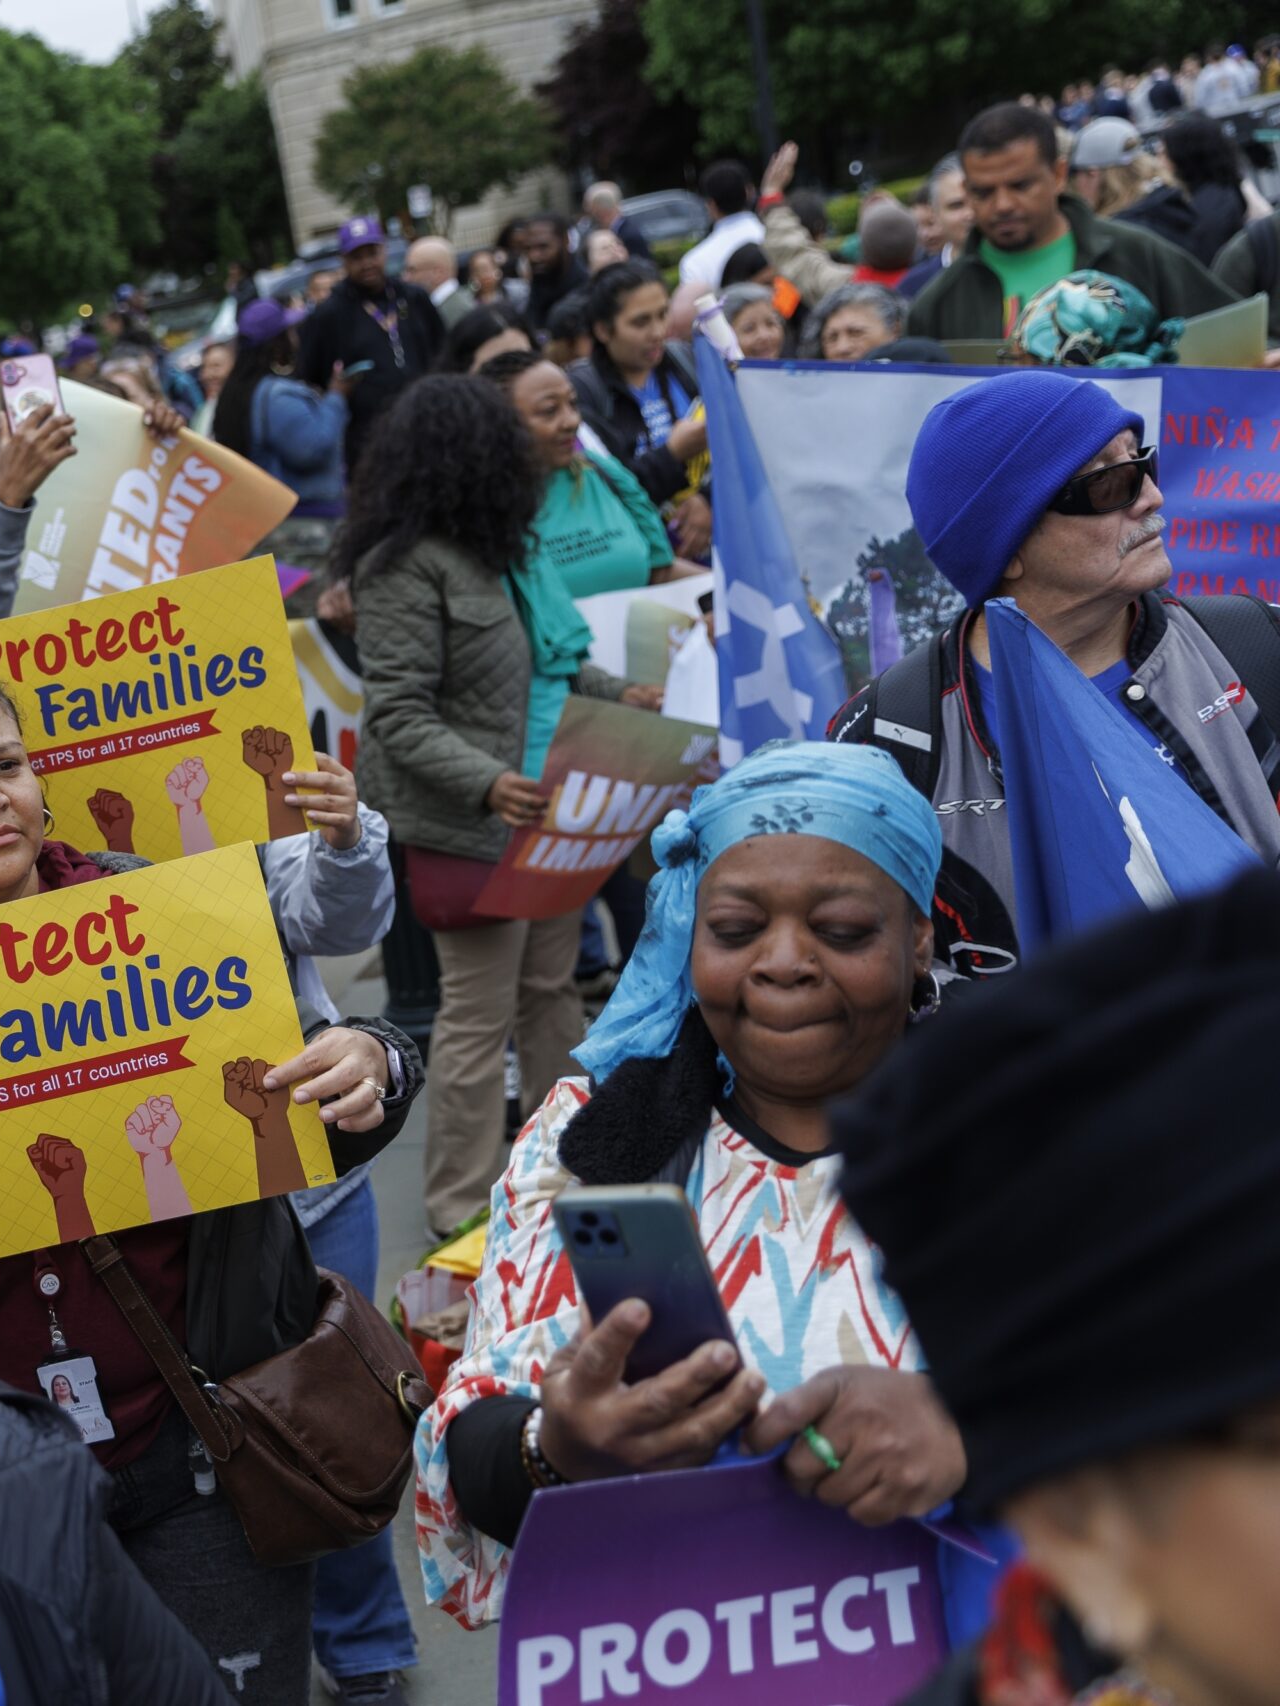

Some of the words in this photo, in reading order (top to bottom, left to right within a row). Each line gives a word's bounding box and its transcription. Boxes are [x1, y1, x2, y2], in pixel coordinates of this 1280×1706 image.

[1164, 406, 1255, 450] NIÑA
[1168, 516, 1241, 554] PIDE
[34, 644, 267, 737] Families
[47, 750, 75, 766] TPS
[76, 747, 97, 761] for
[99, 740, 116, 756] all
[118, 735, 134, 751] 17
[137, 722, 201, 746] countries
[934, 798, 1006, 816] SRT
[11, 1082, 37, 1099] for
[41, 1074, 61, 1092] all
[65, 1068, 84, 1088] 17
[88, 1050, 169, 1082] countries
[78, 1379, 94, 1387] STAFF
[517, 1565, 920, 1706] PROTECT
